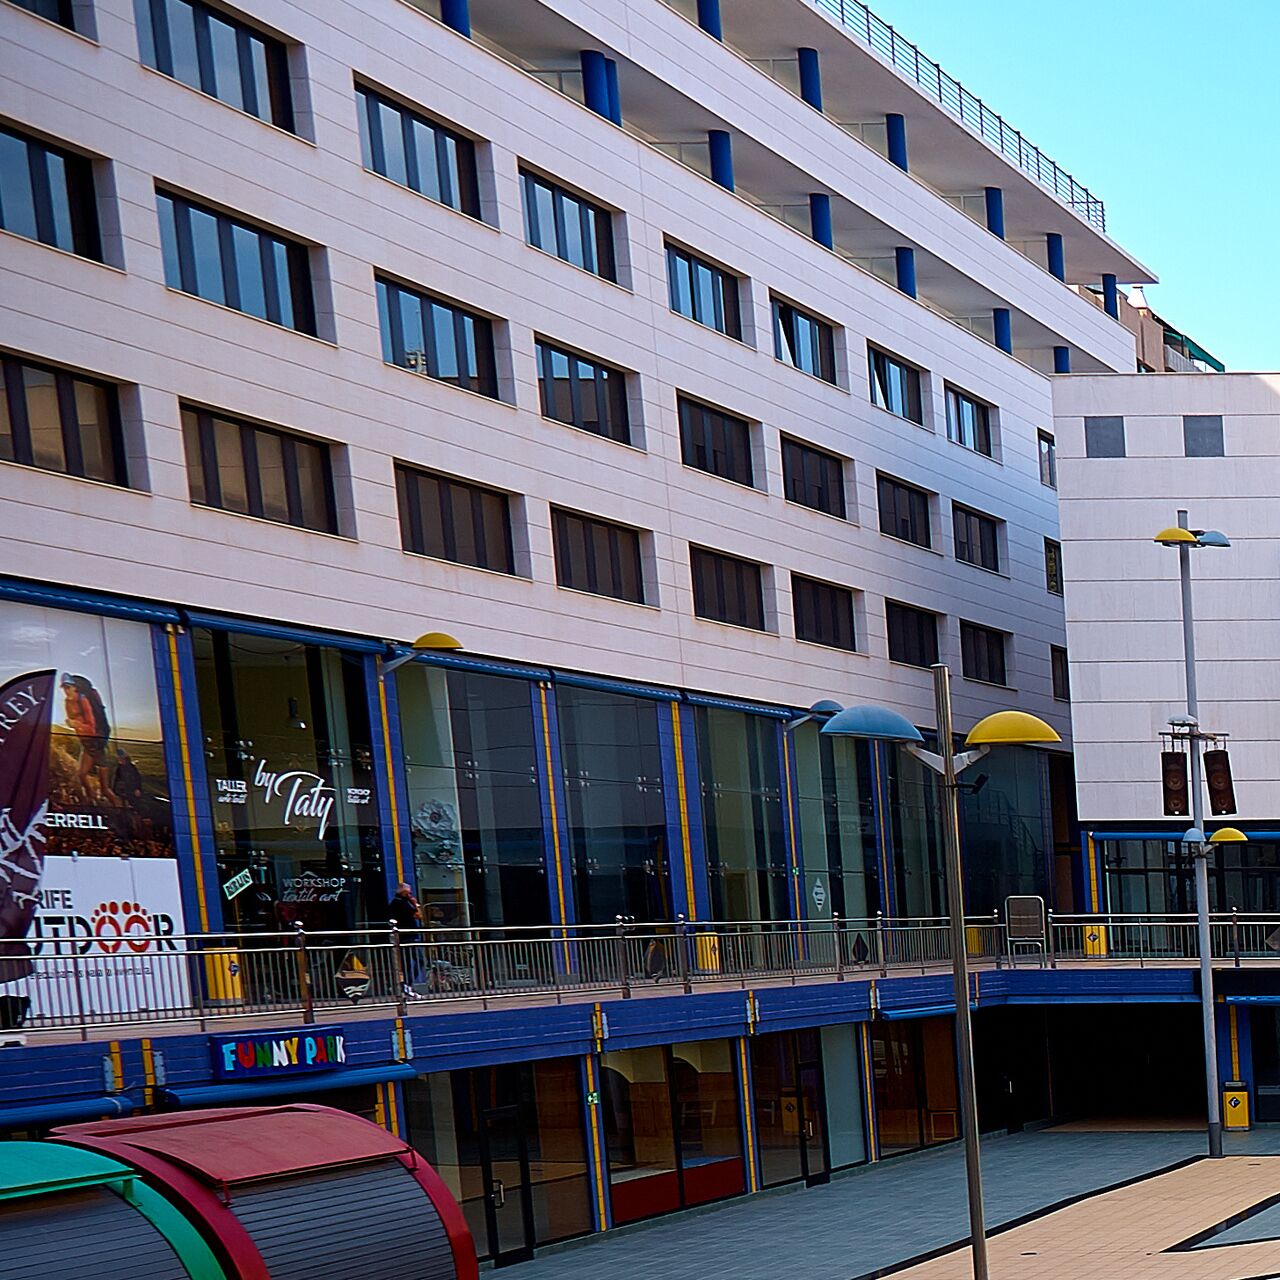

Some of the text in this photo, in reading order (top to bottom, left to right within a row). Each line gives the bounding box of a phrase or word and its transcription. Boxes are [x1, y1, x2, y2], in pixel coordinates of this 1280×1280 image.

[254, 759, 337, 840] by Taty
[44, 812, 110, 830] ERRELL
[282, 878, 346, 888] WORKSHOP
[222, 1035, 346, 1071] FUNNY PARK
